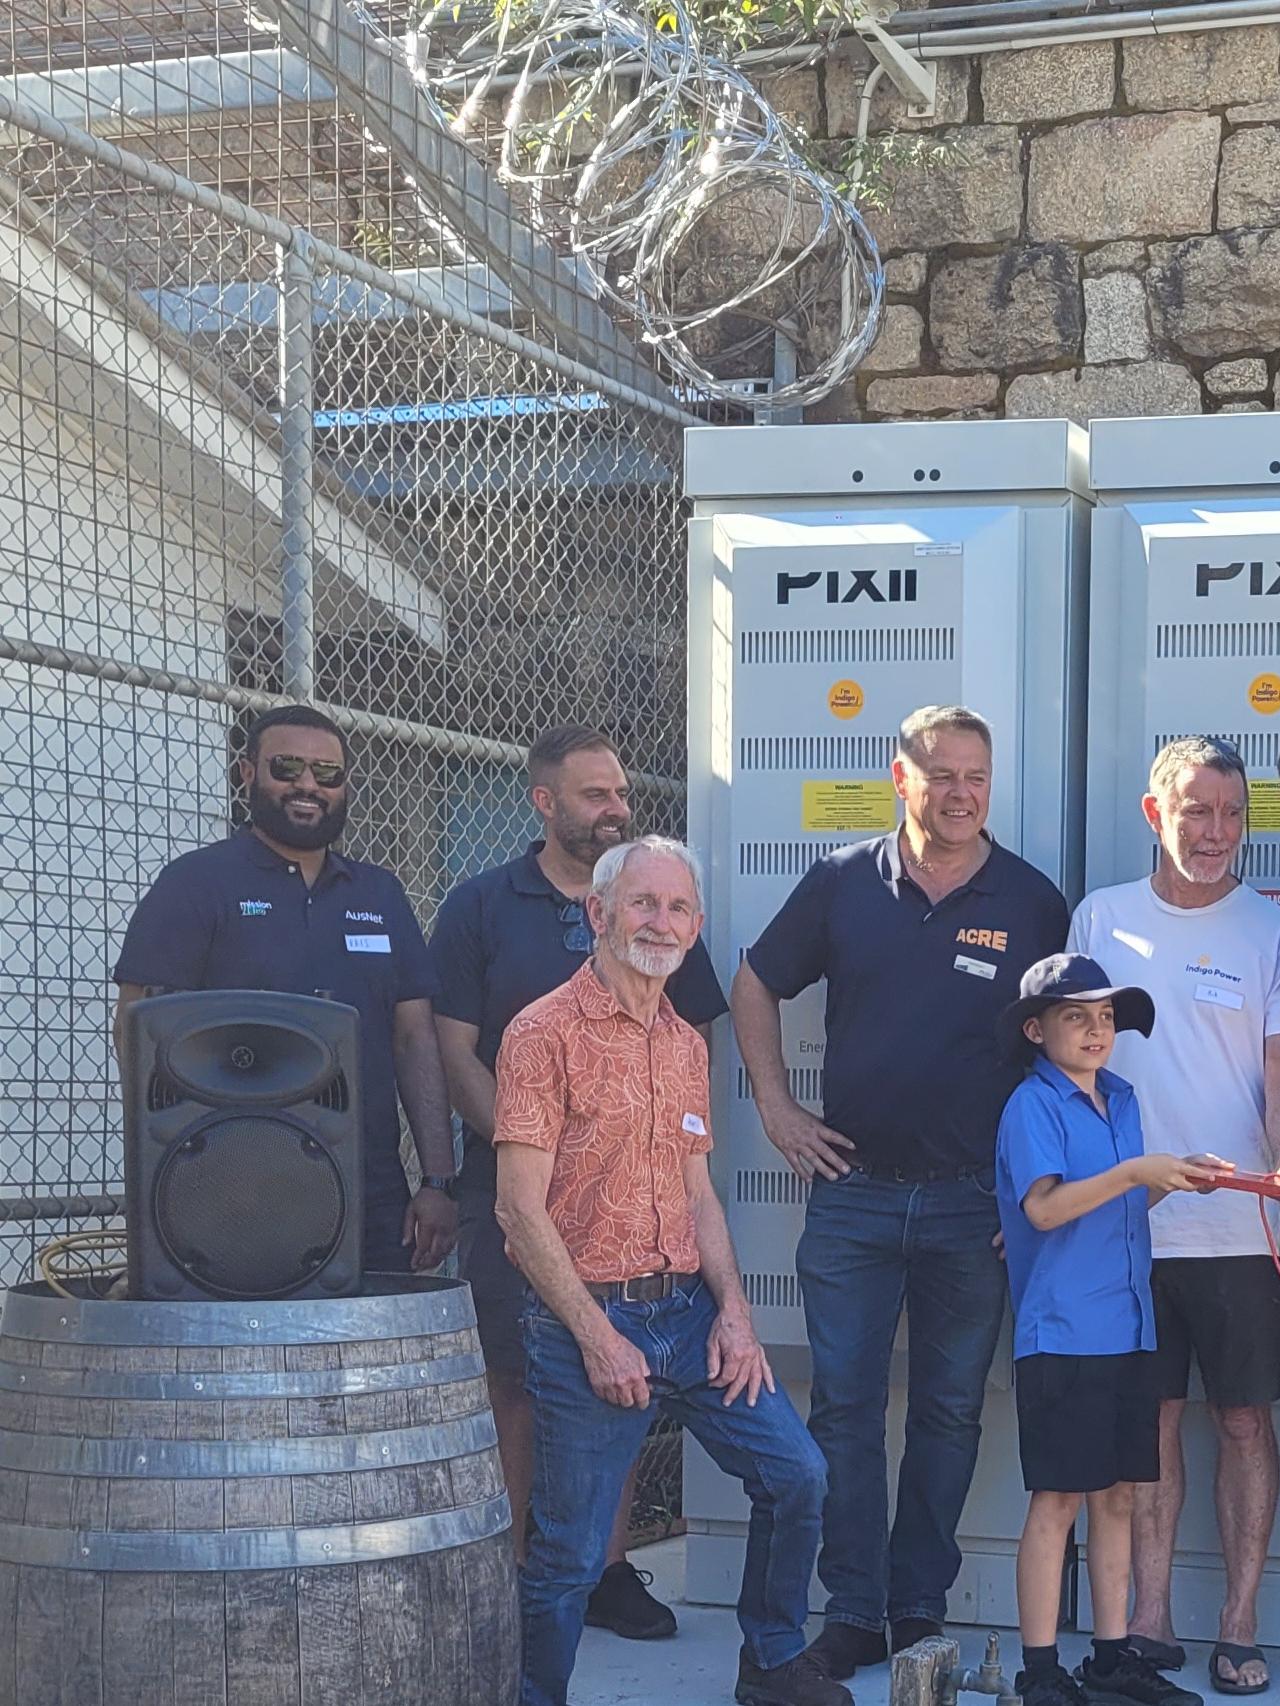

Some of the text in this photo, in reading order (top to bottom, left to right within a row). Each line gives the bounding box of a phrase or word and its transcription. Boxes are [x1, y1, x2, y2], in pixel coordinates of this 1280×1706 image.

[777, 569, 917, 604] PIXII
[955, 928, 1008, 953] ACRE
[1185, 964, 1242, 983] Indigo Power
[799, 1040, 824, 1053] Ener
